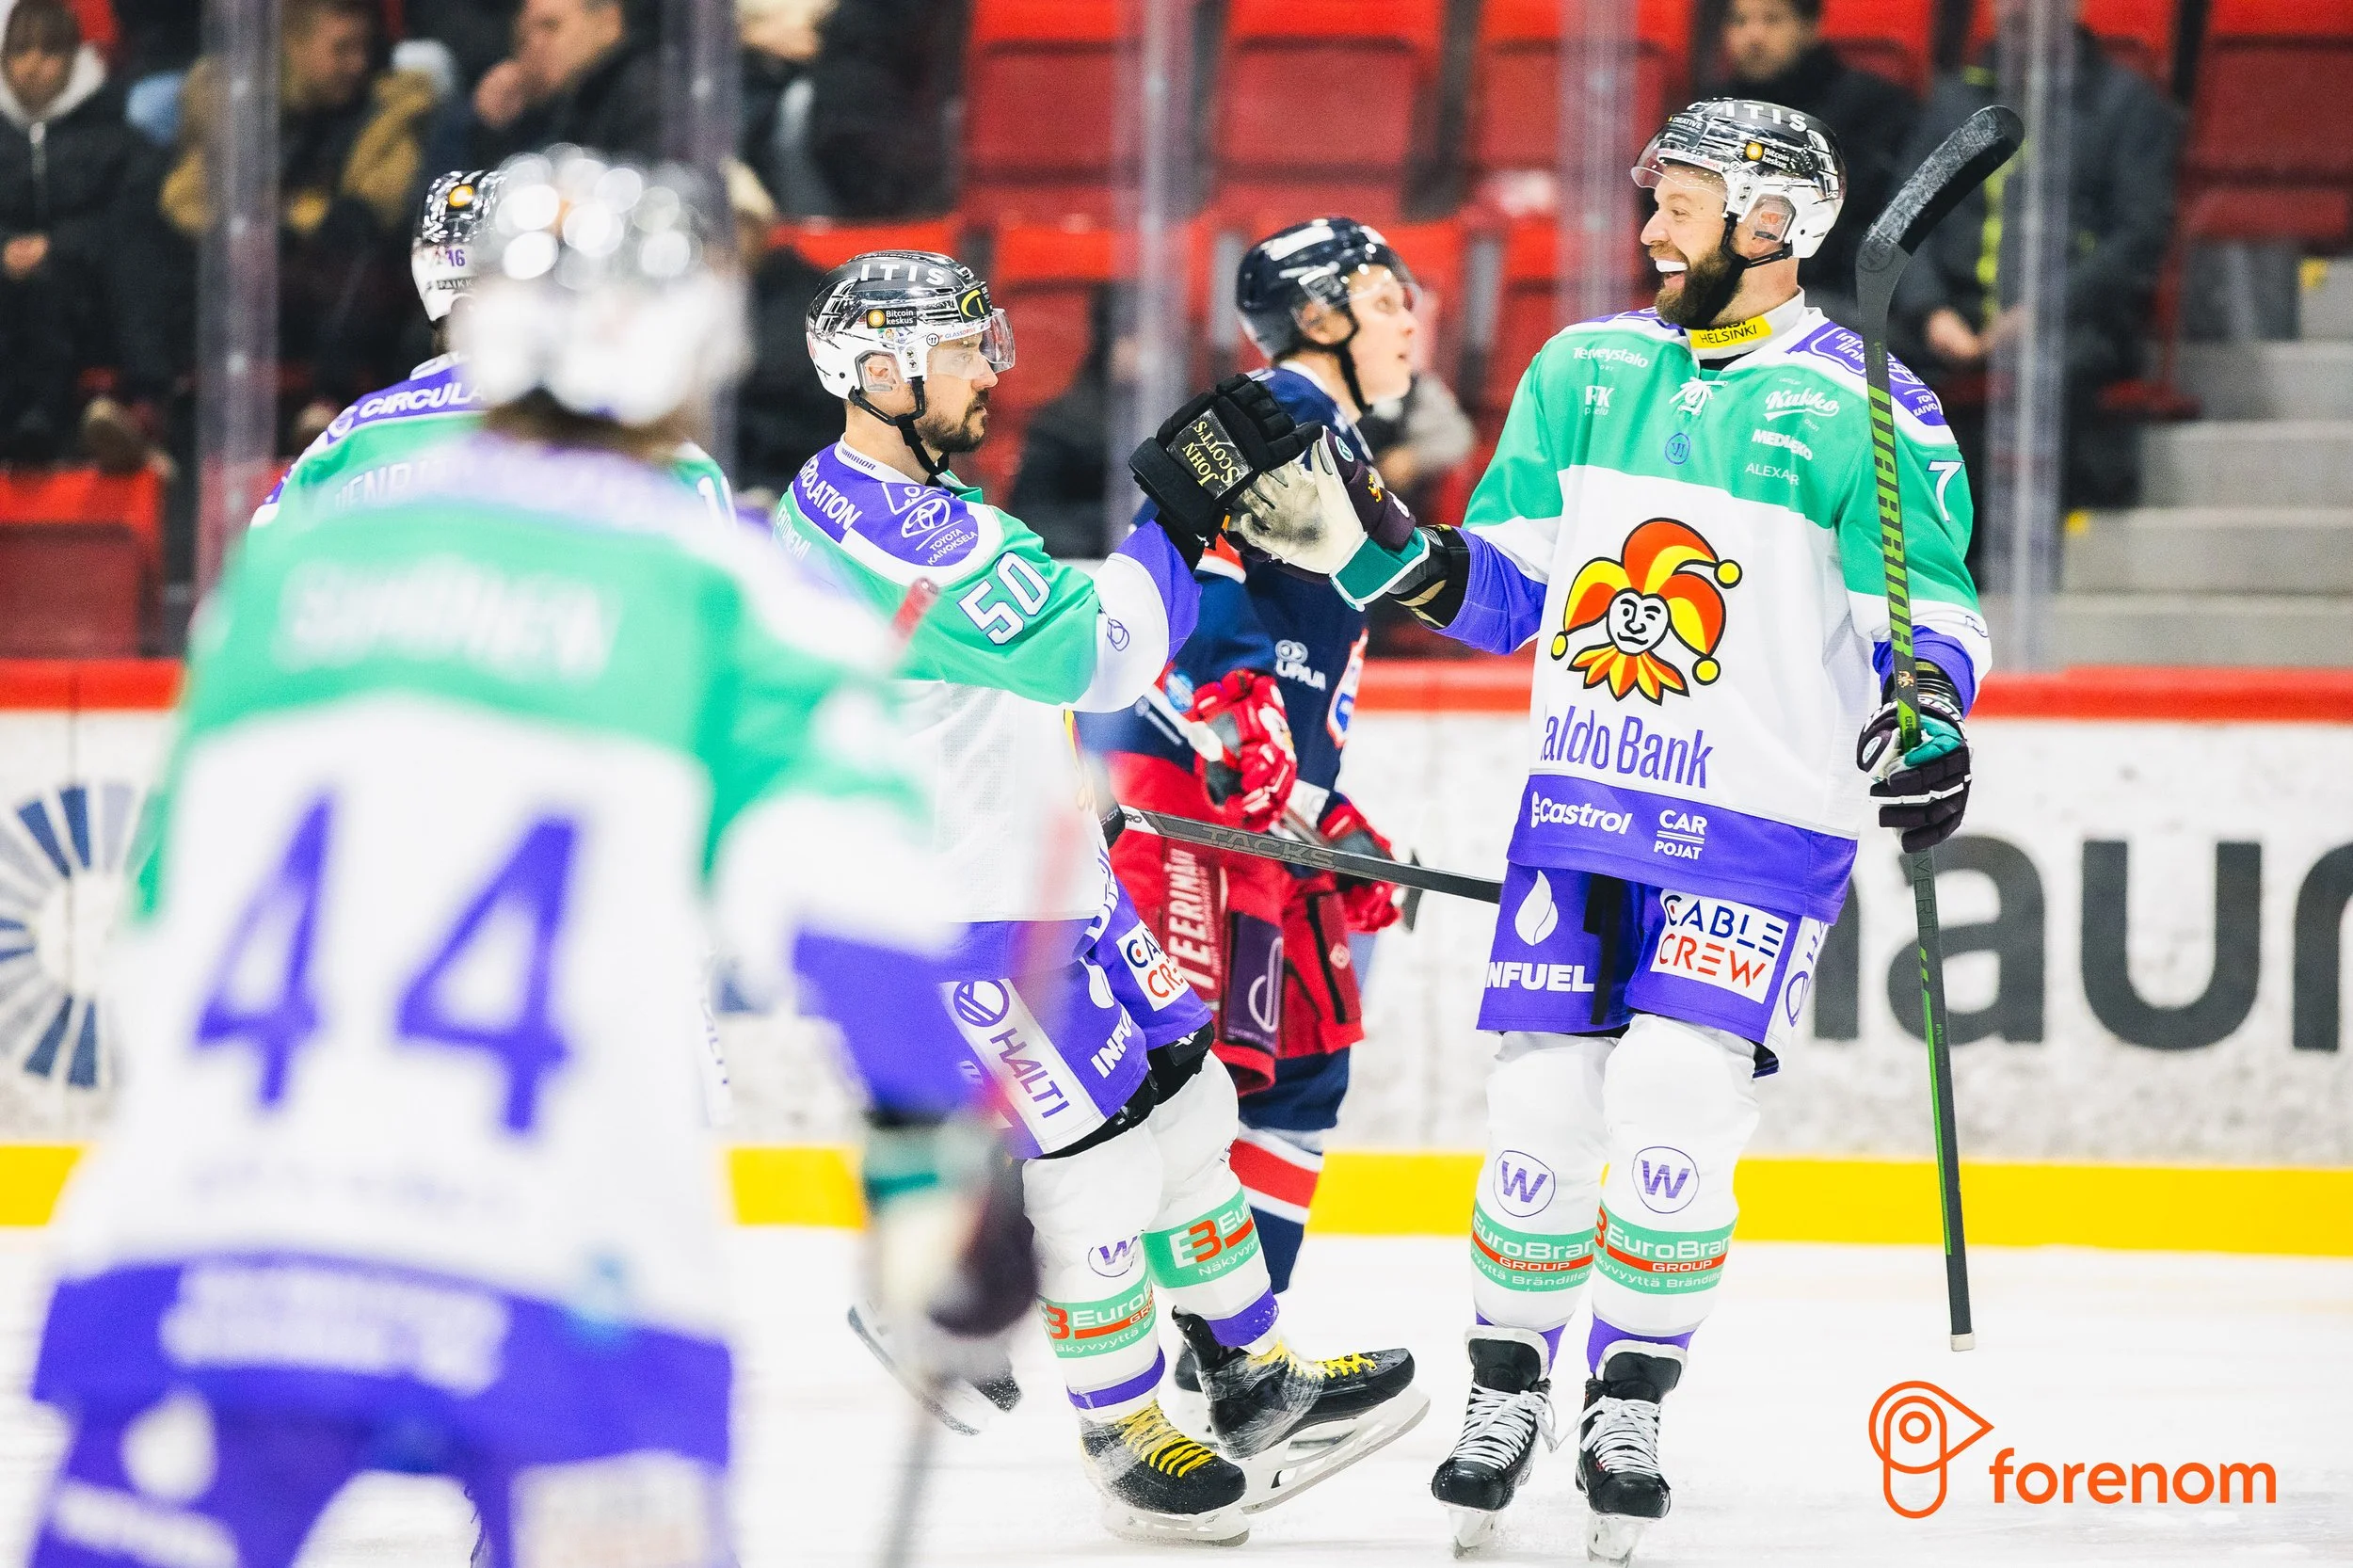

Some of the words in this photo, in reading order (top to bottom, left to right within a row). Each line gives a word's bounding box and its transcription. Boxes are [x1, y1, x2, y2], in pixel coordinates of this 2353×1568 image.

[1725, 103, 1808, 132] ITIS
[1762, 155, 1788, 169] keskus
[1764, 147, 1790, 162] Bitcoin
[447, 248, 466, 267] 16
[859, 264, 945, 285] ITIS
[886, 309, 914, 318] Bitcoin
[886, 316, 914, 326] keskus
[1699, 325, 1758, 344] HELSINKI
[1182, 440, 1221, 488] JOHN
[1868, 384, 1914, 659] WARRIOR
[927, 531, 979, 565] KAIVOKSELA
[929, 528, 964, 552] TOYOTA
[957, 552, 1051, 645] 50
[1541, 705, 1610, 770] aldo
[1616, 715, 1714, 789] Bank
[1539, 797, 1633, 835] Castrol
[1658, 809, 1708, 836] CAR
[1203, 826, 1335, 869] TACKS
[1654, 840, 1703, 860] POJAT
[1663, 894, 1785, 958] CABLE
[191, 791, 587, 1132] 44
[1659, 934, 1767, 988] CREW
[1485, 961, 1595, 993] NFUEL
[989, 1028, 1070, 1119] HALTI
[1501, 1160, 1548, 1204] W
[1641, 1160, 1691, 1199] W
[1499, 1256, 1571, 1272] GROUP
[1652, 1259, 1713, 1272] GROUP
[1054, 1328, 1139, 1353] äkyvyyttä
